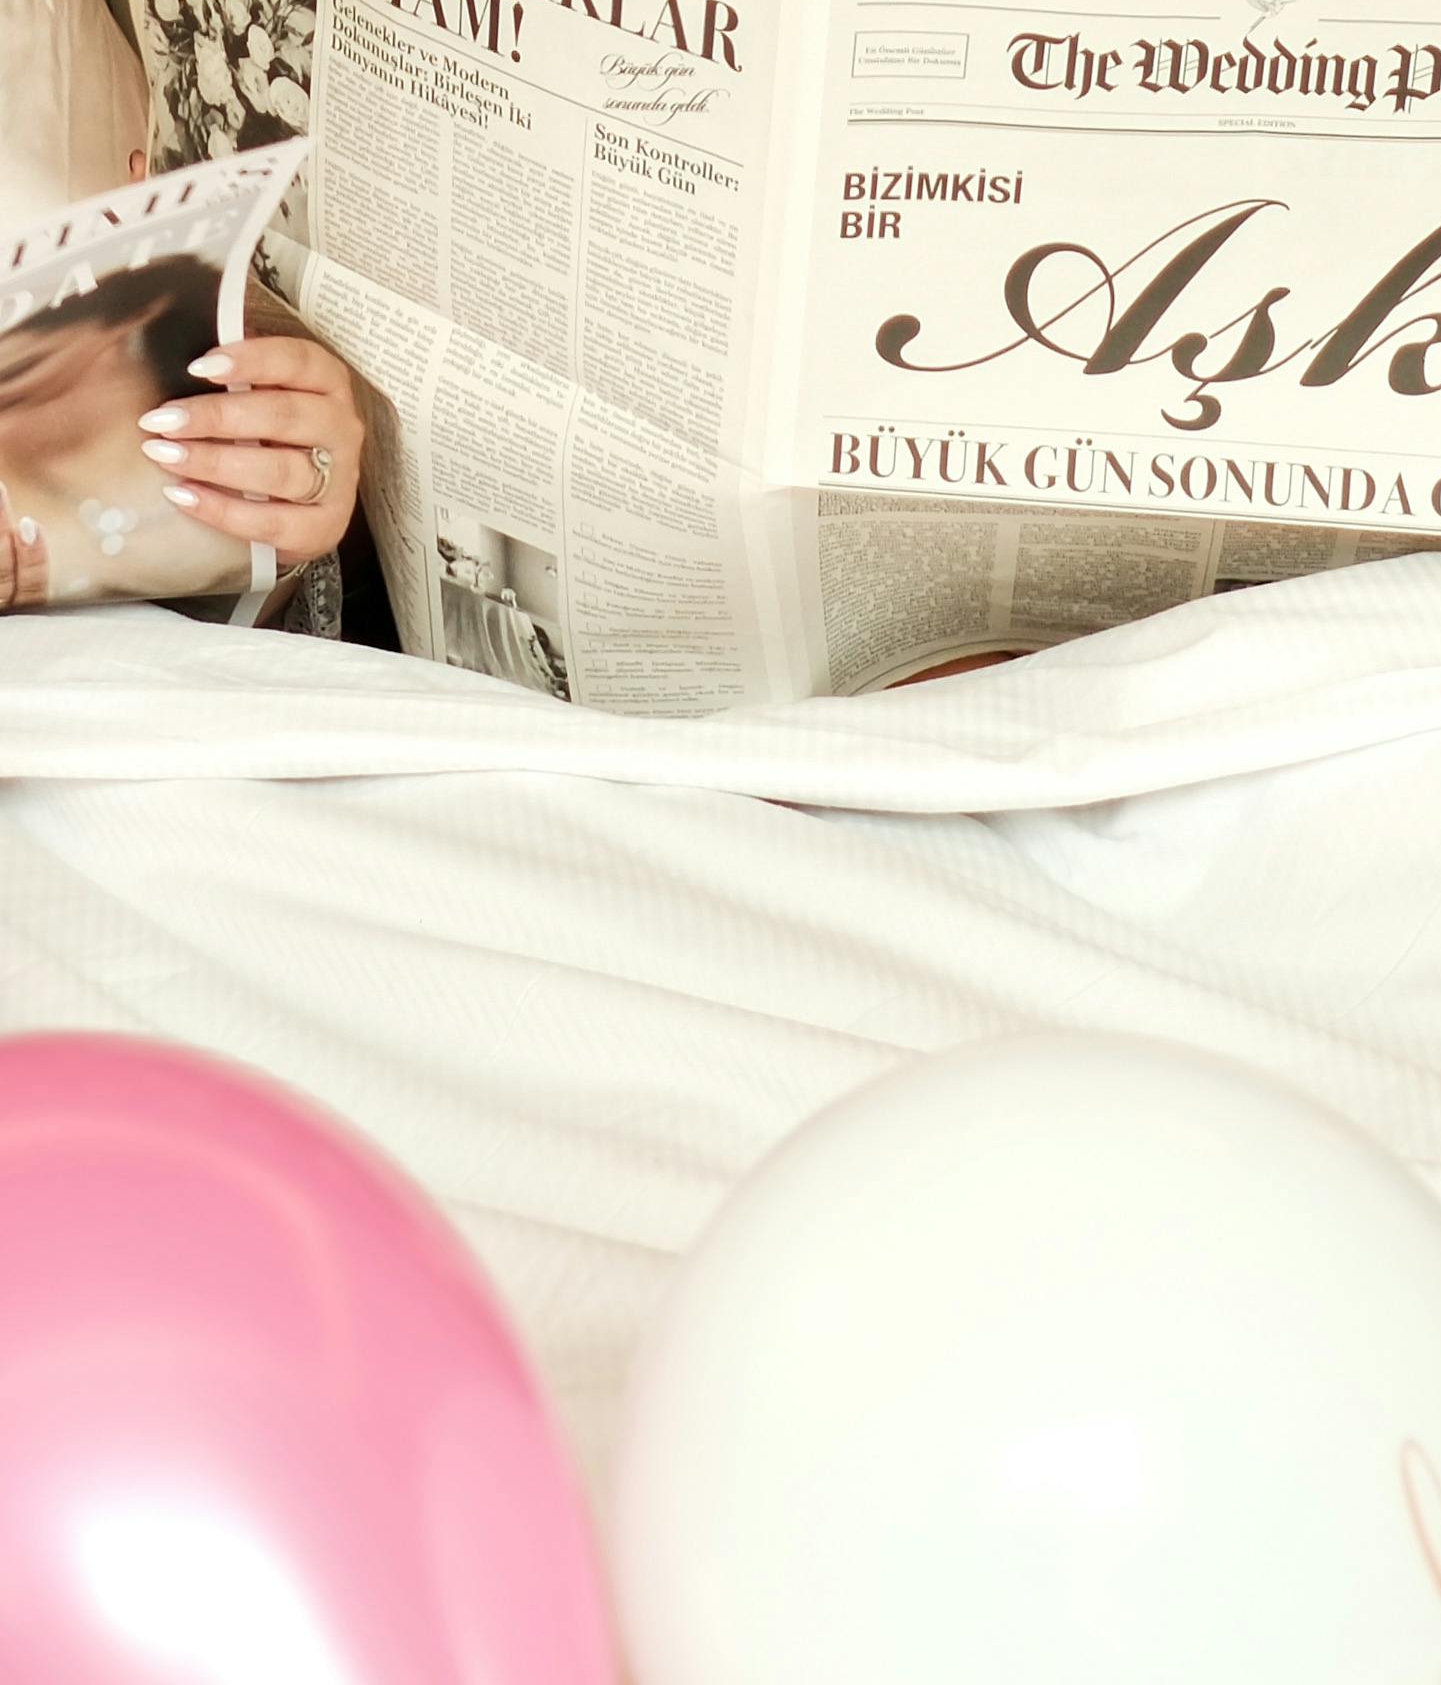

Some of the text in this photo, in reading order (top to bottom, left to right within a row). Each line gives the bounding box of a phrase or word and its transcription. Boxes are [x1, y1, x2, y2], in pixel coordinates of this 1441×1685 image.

[331, 33, 490, 131] Dünyanın Hikâyesi!
[419, 47, 439, 67] ve
[442, 54, 509, 101] Modern
[434, 71, 504, 119] Birleşen
[508, 100, 533, 131] İki
[1006, 31, 1122, 102] The
[1130, 34, 1379, 111] Wedding
[593, 142, 697, 195] Büyük Gün
[594, 122, 740, 193] Son Kontroller:
[841, 163, 1025, 207] BİZİMKİSİ
[839, 203, 902, 240] BİR
[828, 424, 1009, 488] BÜYÜK
[1023, 436, 1143, 496] GÜN
[1146, 451, 1415, 517] SONUNDA
